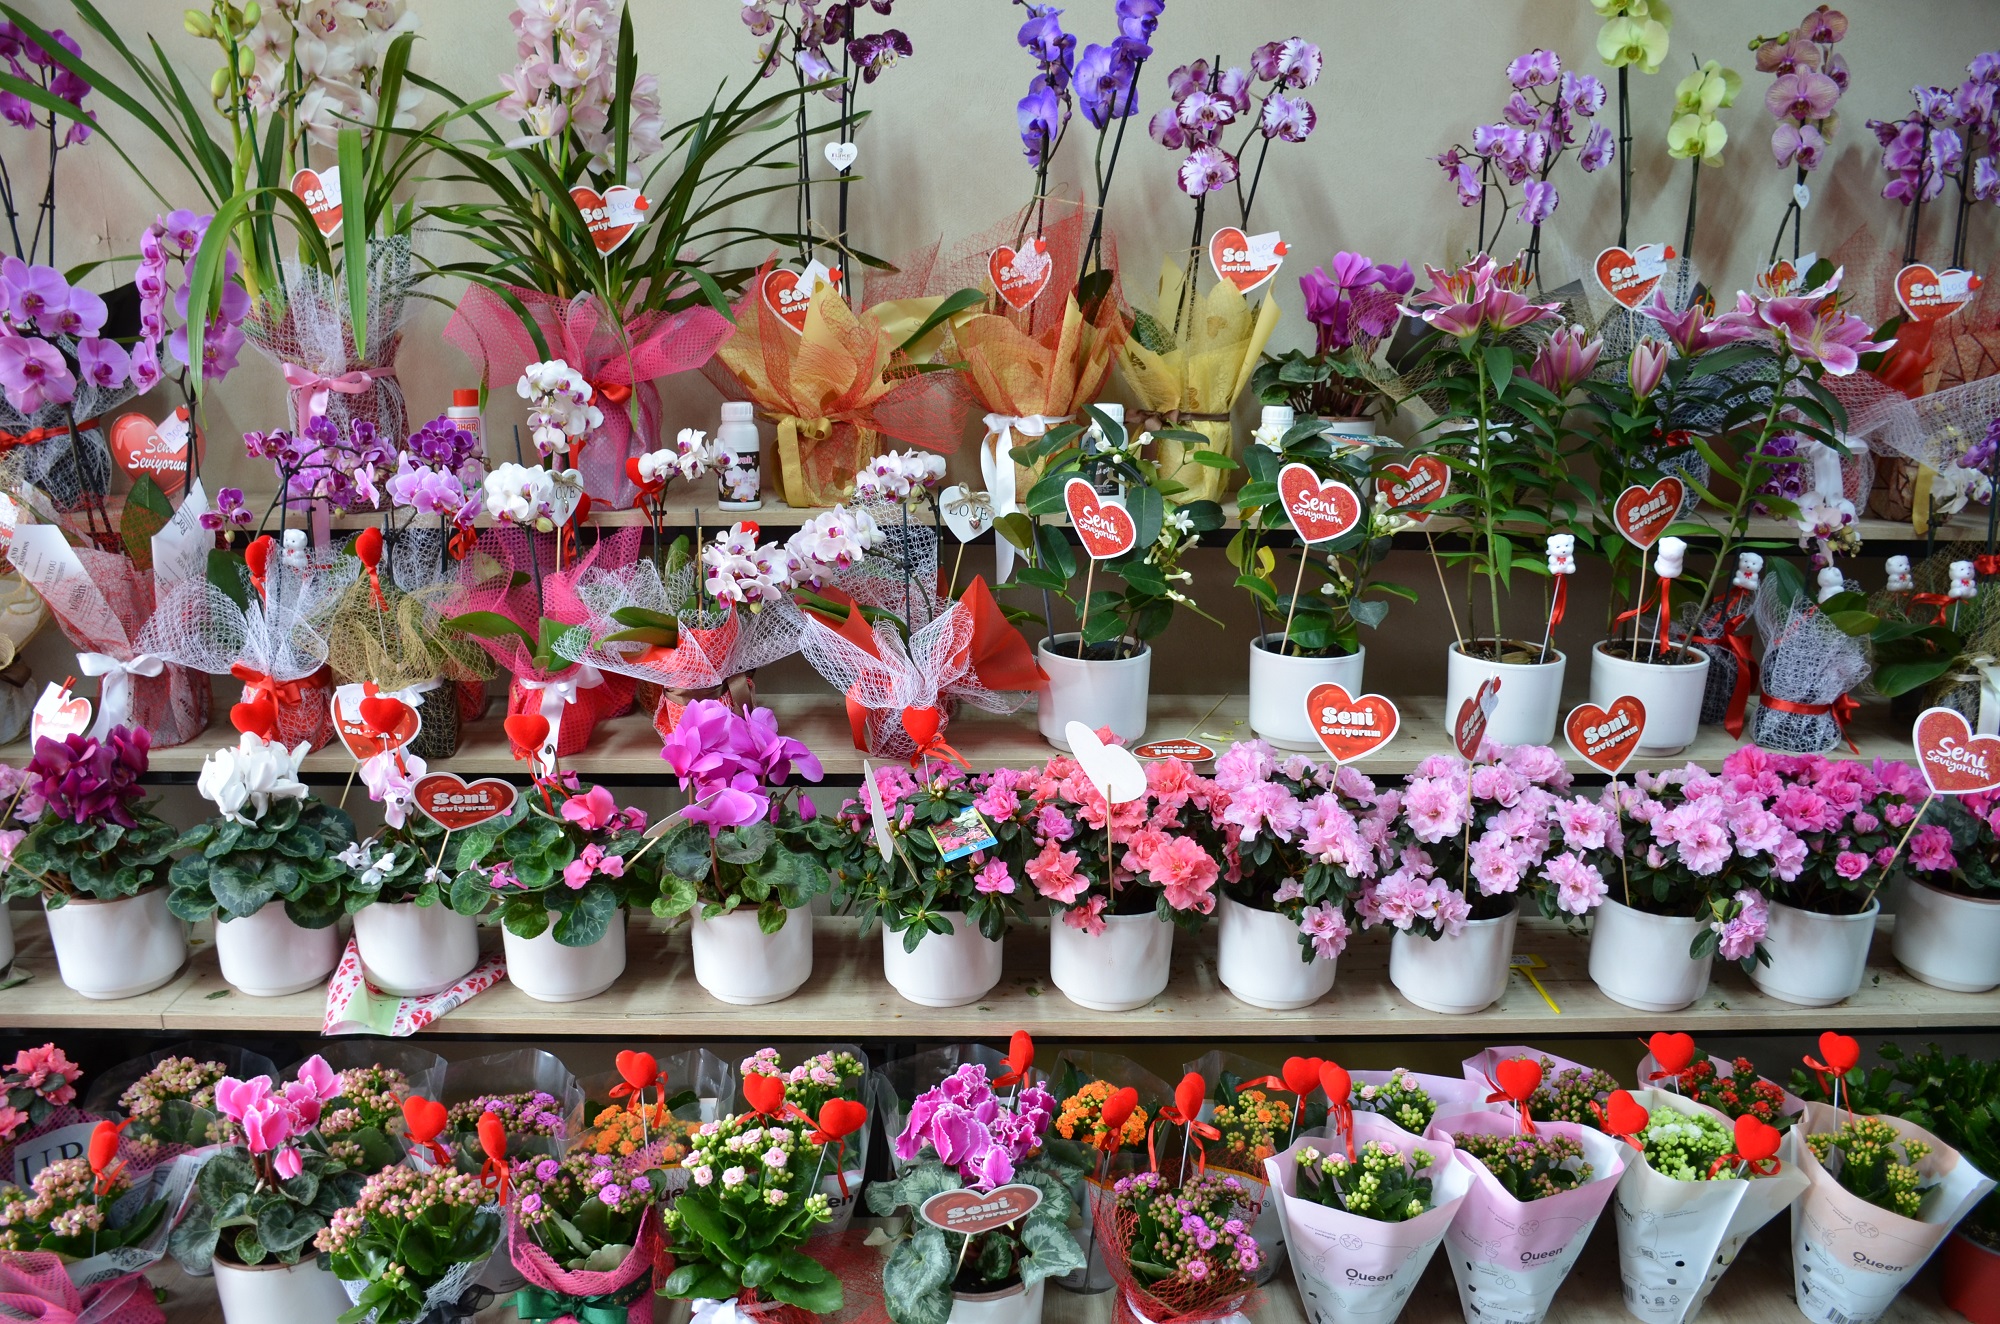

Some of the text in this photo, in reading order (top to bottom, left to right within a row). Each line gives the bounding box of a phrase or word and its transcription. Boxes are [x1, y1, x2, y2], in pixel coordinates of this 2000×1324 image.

[579, 207, 609, 224] Se
[1222, 247, 1250, 262] Se
[1609, 265, 1638, 282] Se
[1909, 283, 1940, 297] Se
[555, 485, 576, 500] OVE
[1299, 489, 1339, 516] Seni
[1292, 503, 1343, 525] Seviyorum
[1628, 490, 1668, 523] Seni
[1082, 505, 1118, 535] Seni
[1628, 505, 1674, 533] Seviyorum
[1078, 517, 1122, 545] Seviyorum
[1322, 706, 1374, 726] Seni
[1320, 725, 1381, 738] Seviyorum
[1583, 709, 1630, 745] Seni
[1587, 725, 1639, 756] Seviyorum
[1935, 736, 1988, 769] Seni
[1925, 749, 1990, 781] Seviyorum
[432, 790, 489, 805] Seni
[431, 804, 496, 813] Seviyorum
[946, 1196, 1011, 1219] Seni
[946, 1207, 1019, 1226] Seviyorum
[1520, 1247, 1563, 1263] Queen
[1852, 1251, 1903, 1272] Queen
[1345, 1268, 1394, 1282] Queen
